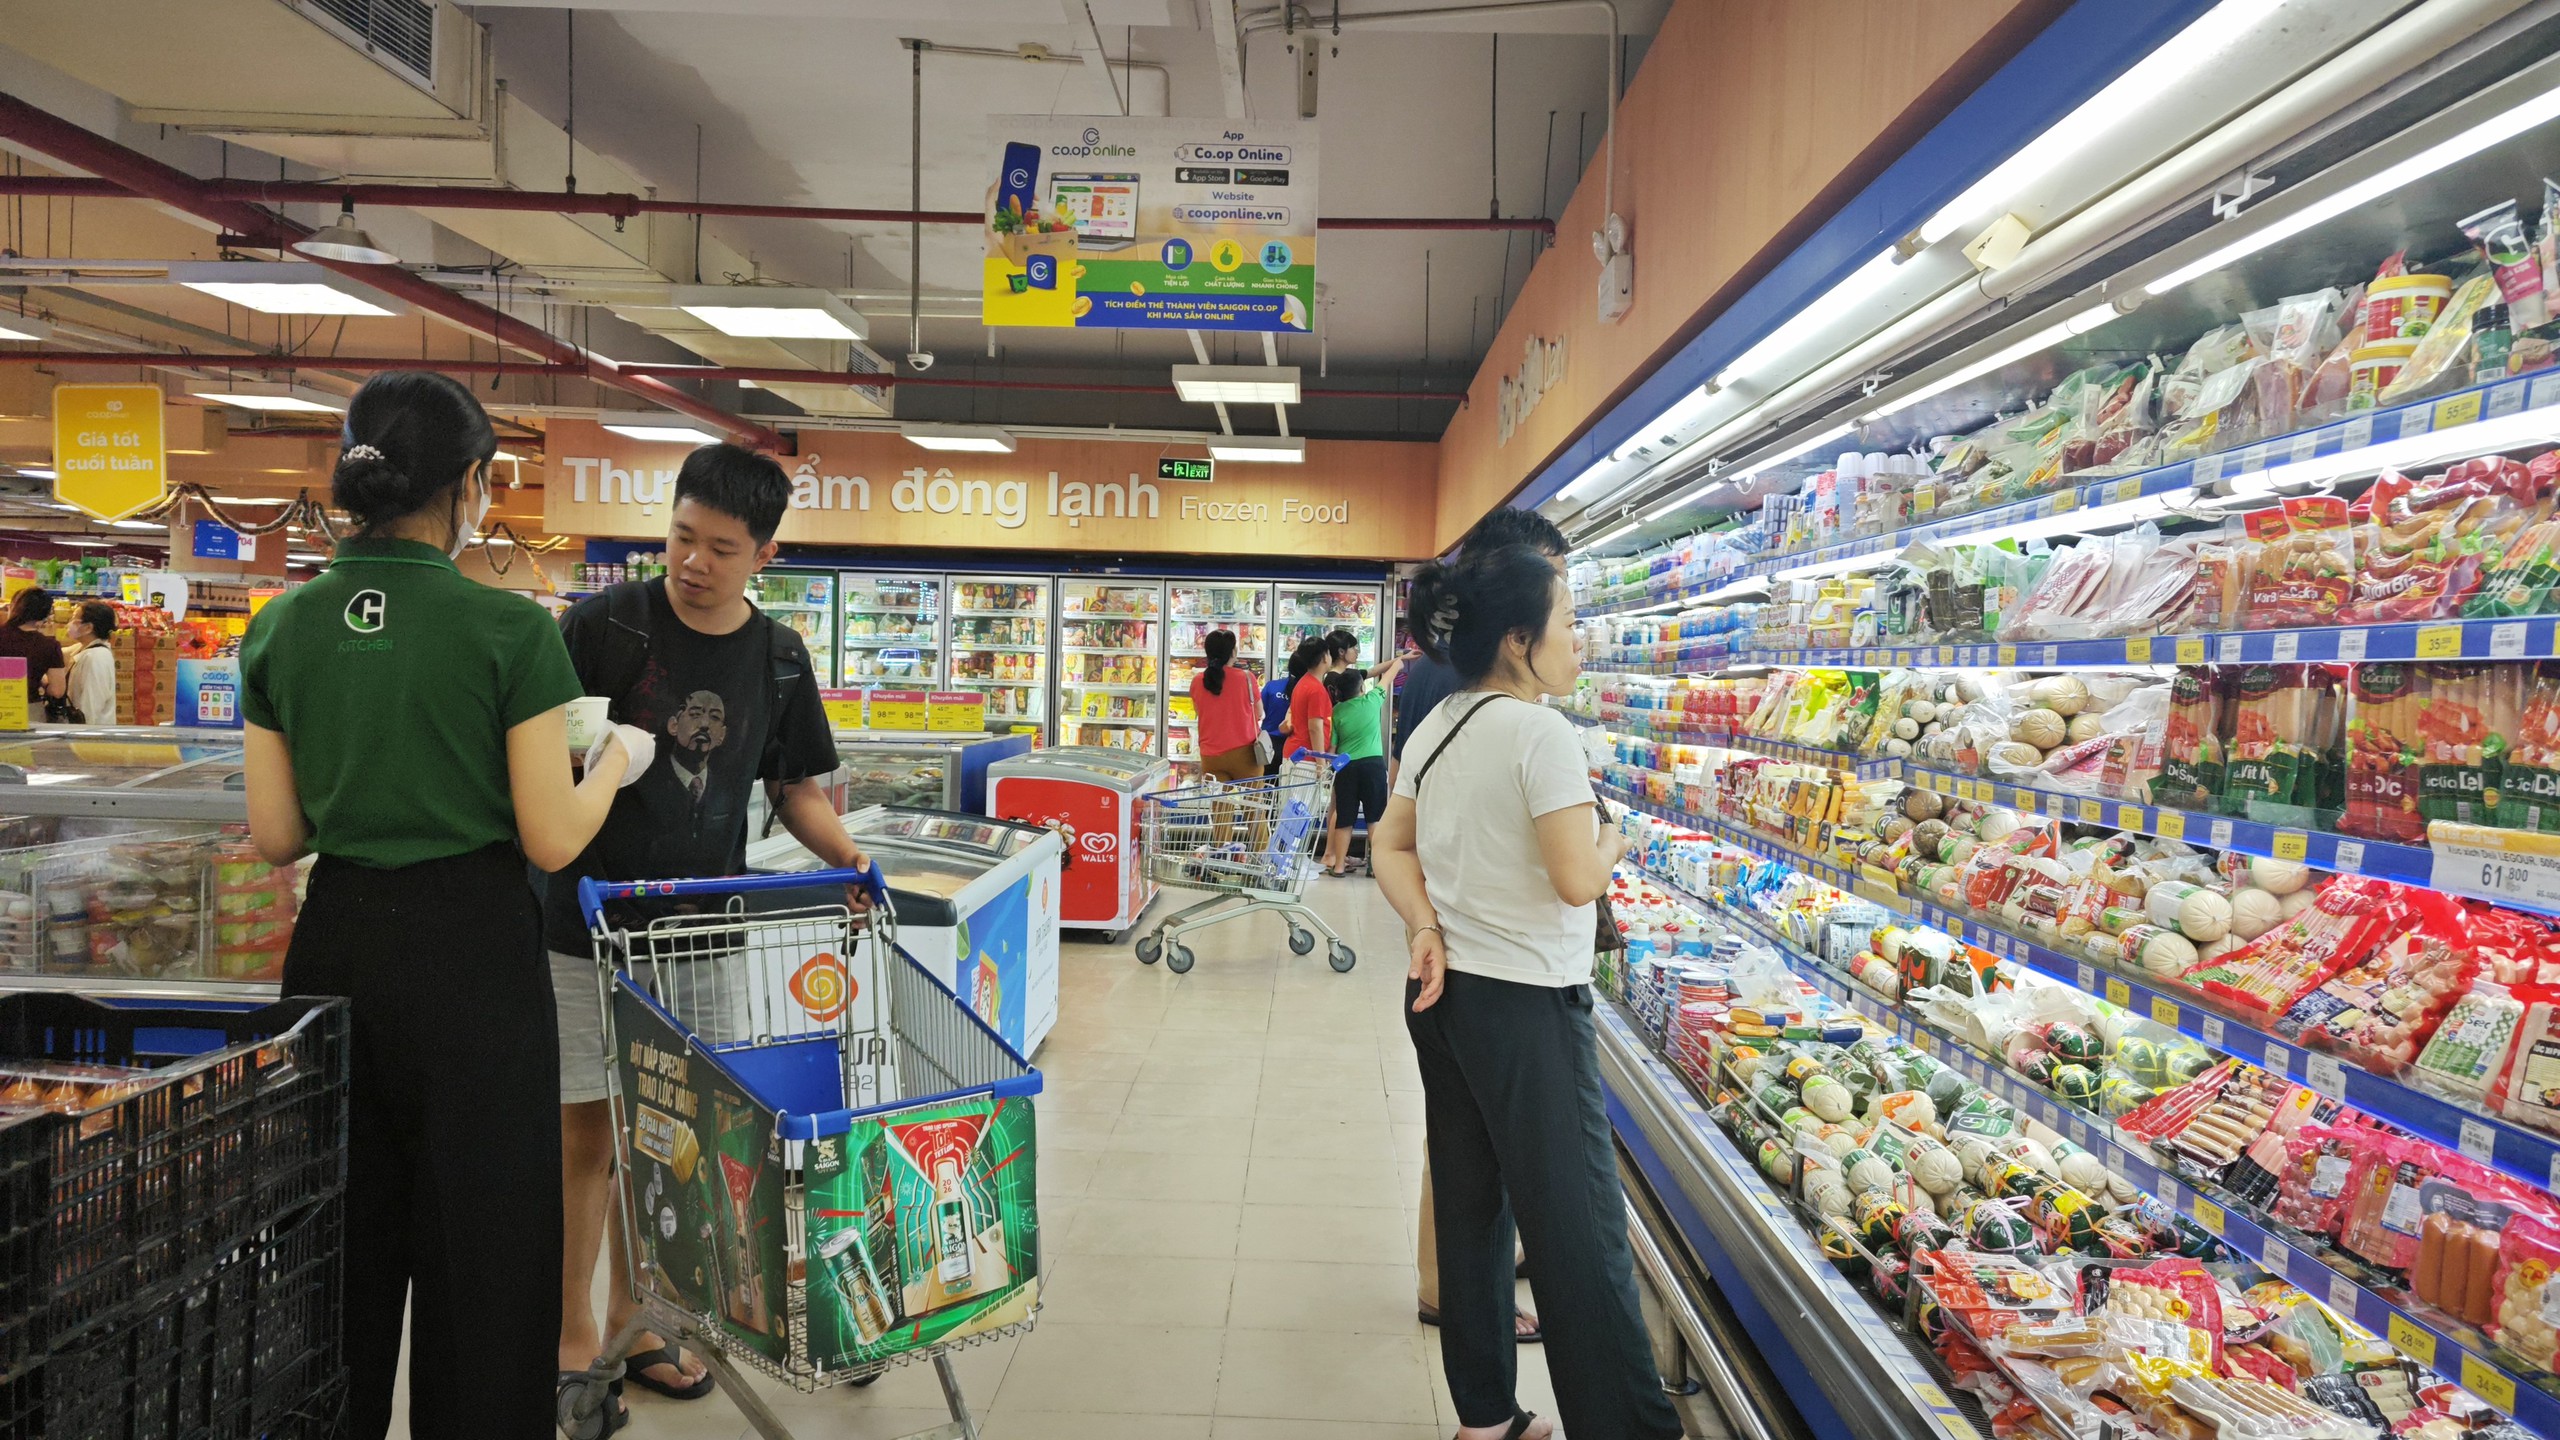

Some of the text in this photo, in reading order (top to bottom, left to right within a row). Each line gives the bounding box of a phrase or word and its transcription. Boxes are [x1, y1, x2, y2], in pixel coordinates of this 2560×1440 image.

[1223, 130, 1244, 141] App
[1194, 147, 1283, 161] Co.op Online
[1192, 174, 1226, 183] App Store
[1250, 175, 1286, 184] Google Play
[1212, 191, 1255, 201] Website
[1188, 208, 1283, 221] cooponline.vn
[1104, 299, 1124, 309] TÍCH
[1125, 299, 1146, 309] ĐIỂM
[1166, 300, 1195, 310] THÀNH
[1197, 301, 1217, 311] VIÊN
[1218, 303, 1250, 311] SAIGON
[1252, 304, 1278, 312] CO.OP
[1147, 311, 1235, 321] KHI MUA SẮM ONLINE
[2446, 405, 2459, 419] 55
[77, 429, 140, 447] Giá tốt
[65, 452, 154, 470] cuối tuần
[1189, 469, 1209, 478] EXIT
[891, 466, 1029, 528] đông
[1047, 472, 1160, 527] lạnh
[1181, 496, 1269, 523] Frozen
[1281, 499, 1350, 524] Food
[240, 537, 253, 546] 04
[337, 638, 394, 652] KITCHEN
[2429, 639, 2440, 650] 35
[873, 693, 894, 701] Khuyến
[931, 694, 953, 702] Khuyến
[905, 711, 914, 719] 98
[2282, 842, 2291, 854] 55
[1081, 854, 1114, 863] WALL'S
[2482, 863, 2503, 888] 61
[658, 1051, 688, 1085] SPECIAL
[814, 1159, 840, 1171] SAIGON
[943, 1186, 952, 1194] 26
[2201, 1205, 2210, 1220] 70
[2400, 1330, 2413, 1347] 28
[2476, 1374, 2490, 1392] 34
